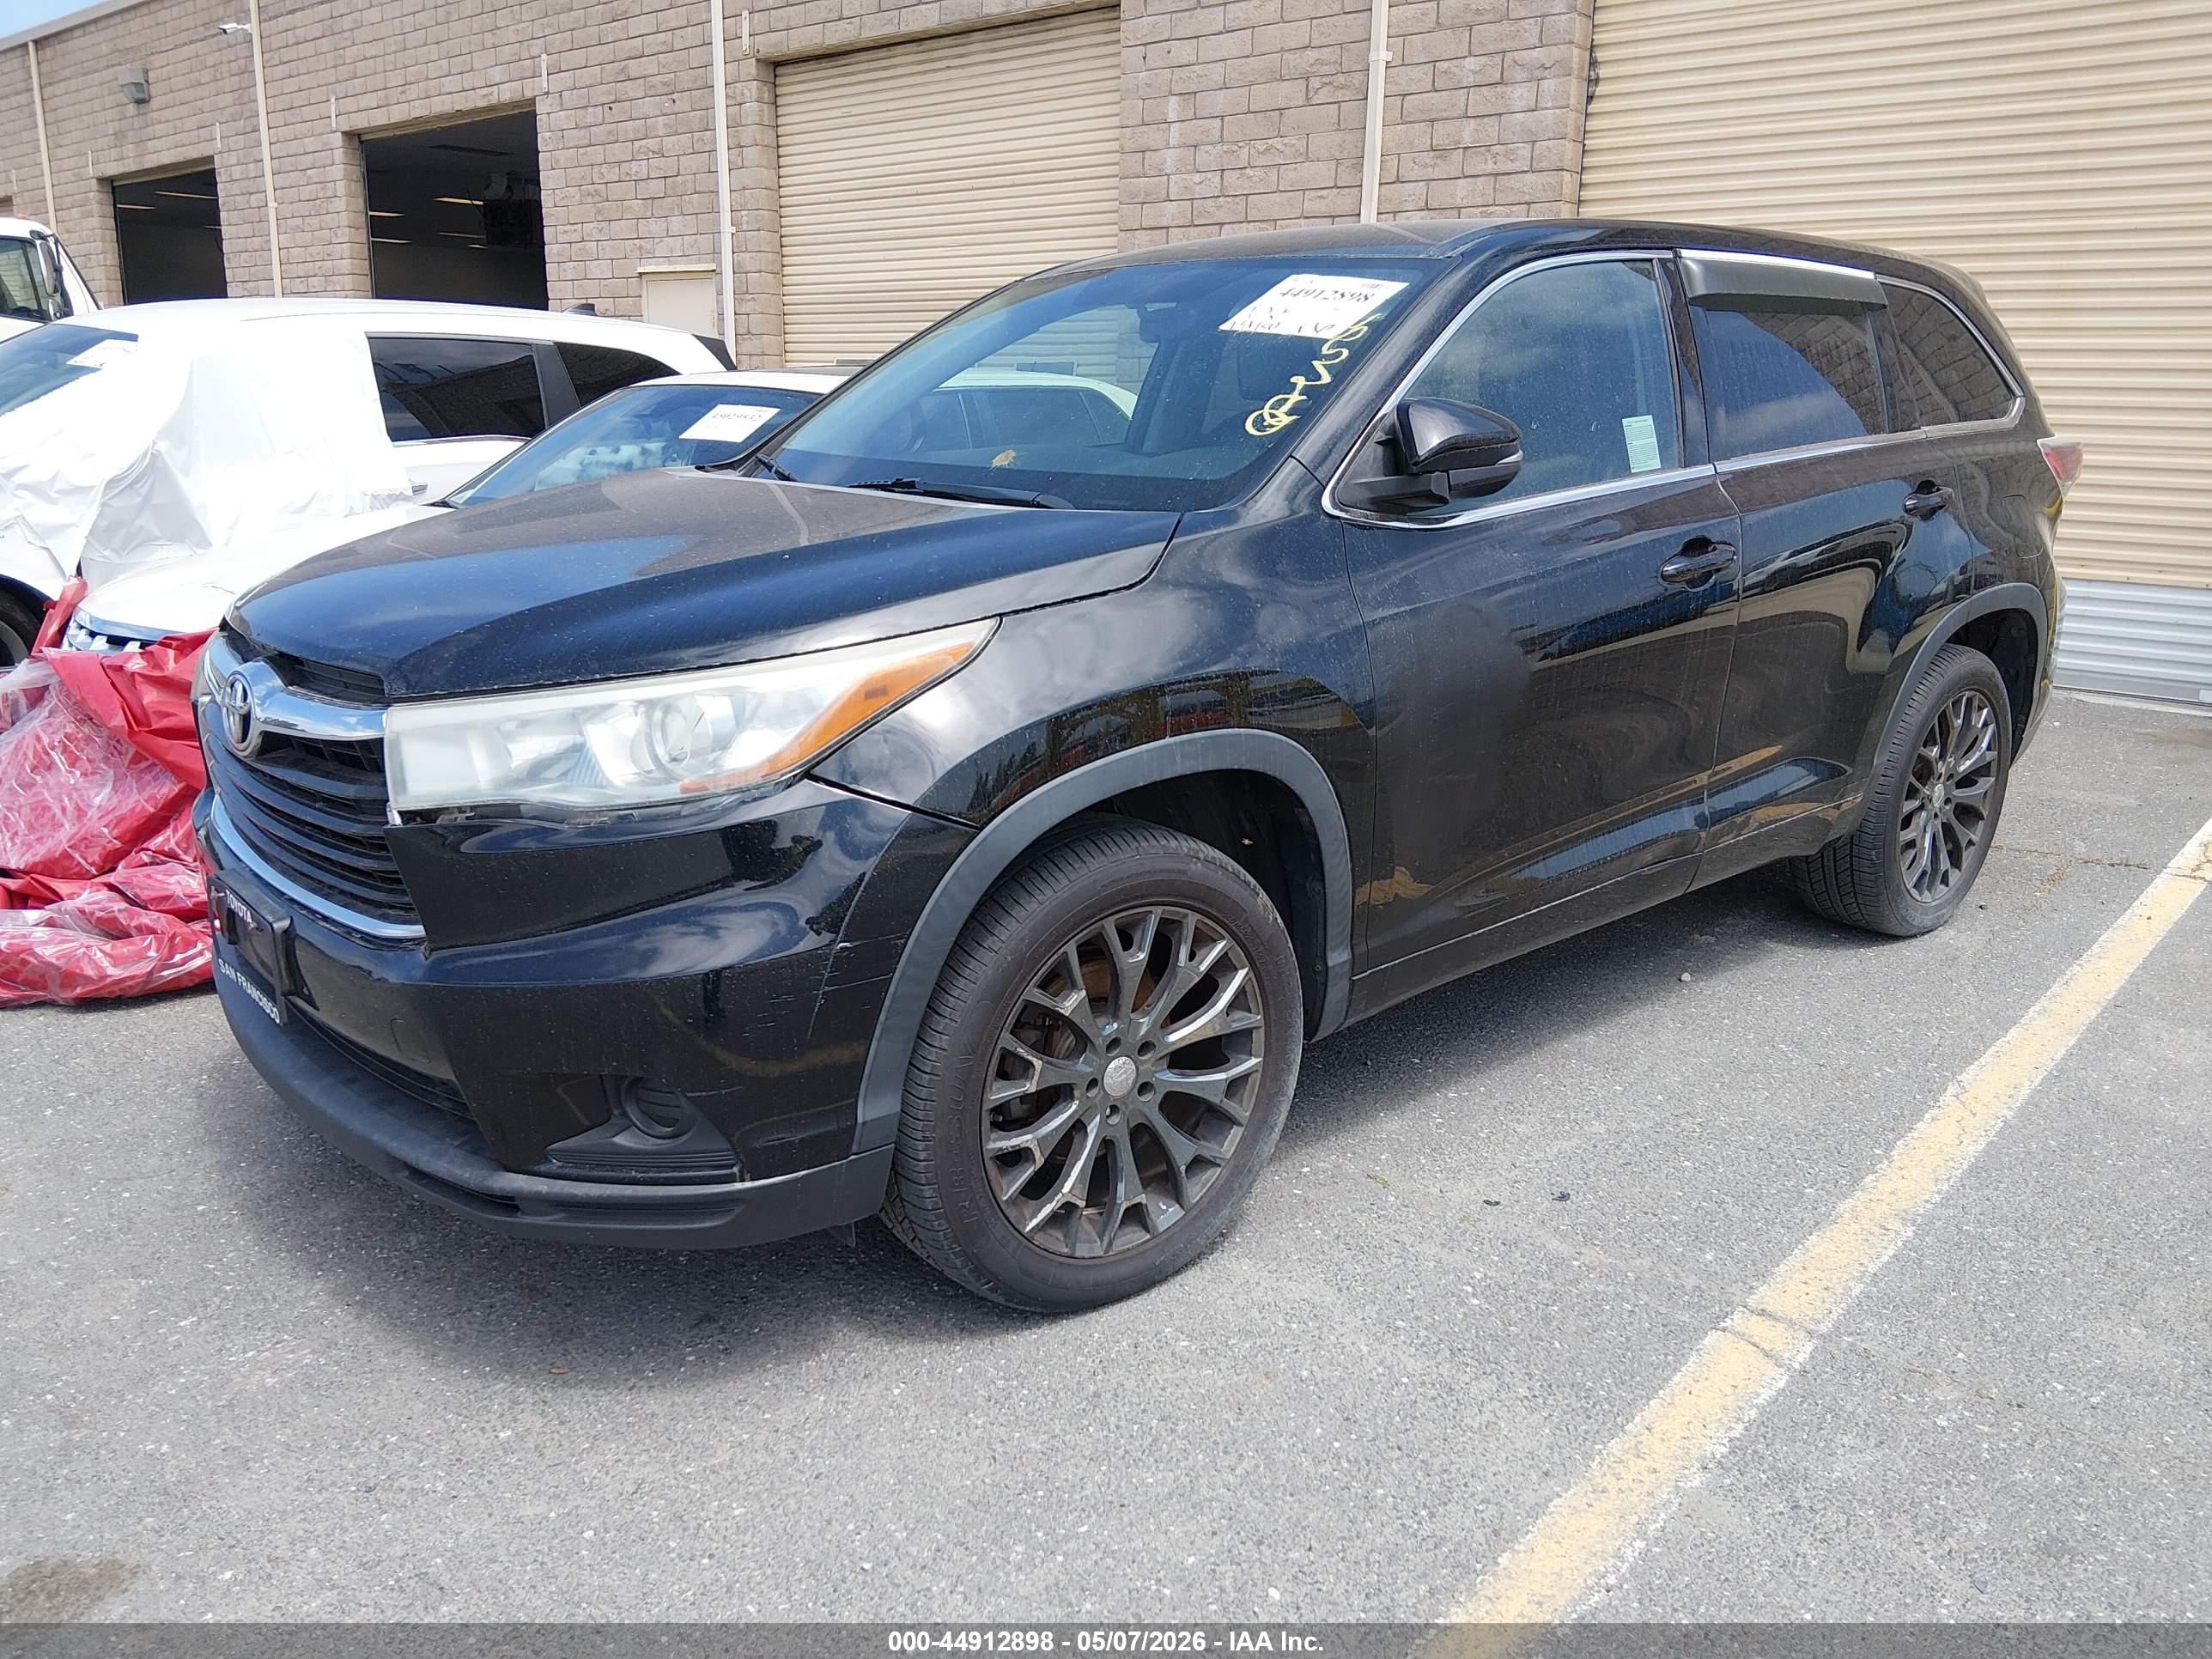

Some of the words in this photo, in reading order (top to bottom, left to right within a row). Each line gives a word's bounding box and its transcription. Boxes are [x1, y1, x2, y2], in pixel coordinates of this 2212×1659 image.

[225, 889, 252, 923] TOYOTA
[218, 957, 237, 983] SAN
[236, 971, 281, 1024] FRANCISCO
